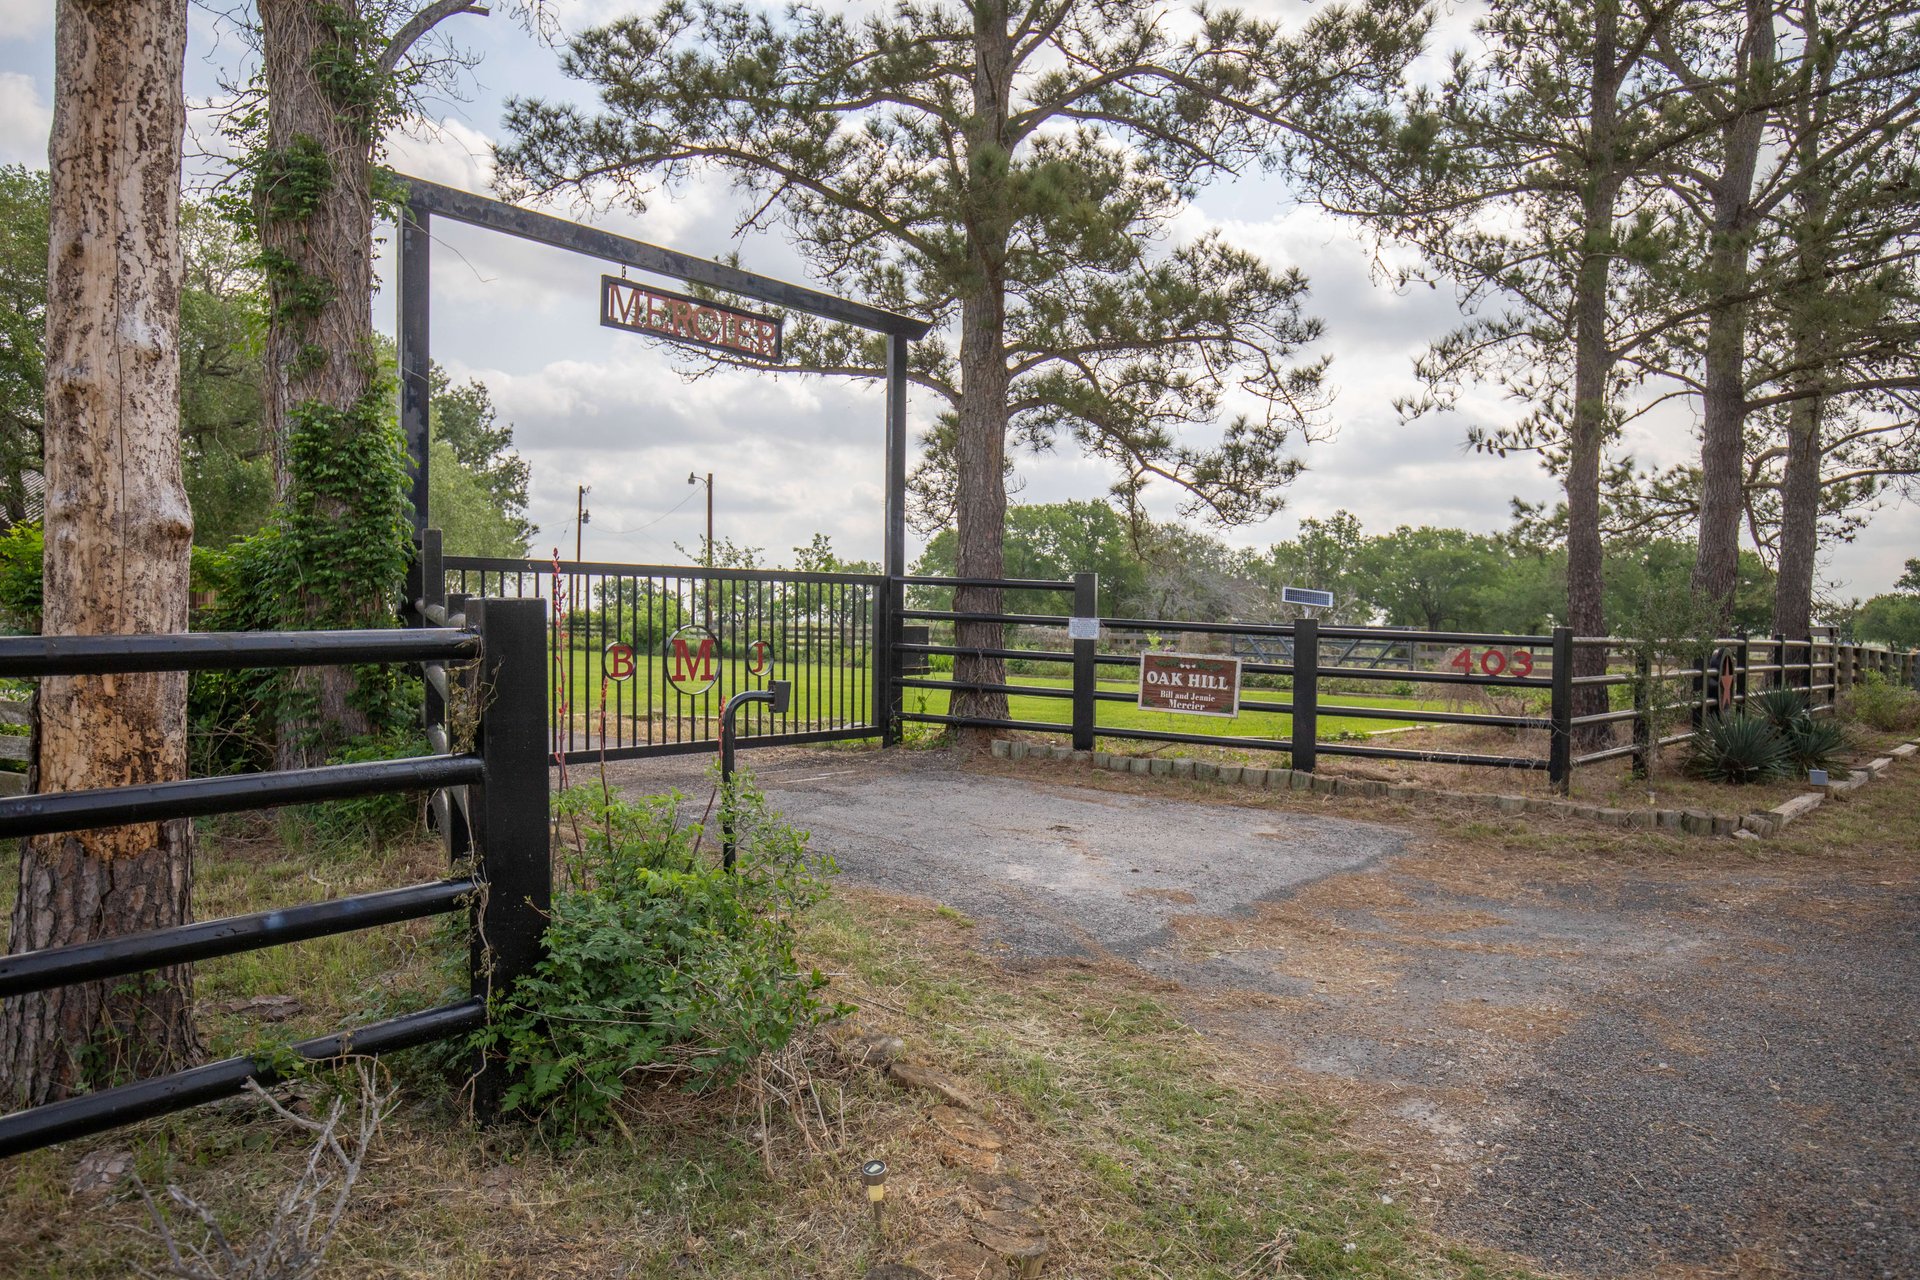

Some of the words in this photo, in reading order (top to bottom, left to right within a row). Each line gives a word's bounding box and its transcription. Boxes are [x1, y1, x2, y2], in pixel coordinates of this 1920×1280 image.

[608, 283, 779, 358] MERCIER
[610, 644, 635, 678] B
[671, 639, 715, 682] M
[752, 641, 768, 673] J
[1451, 647, 1534, 678] 403
[1146, 671, 1184, 687] OAK
[1187, 673, 1229, 690] HILL
[1160, 690, 1173, 699] Bill
[1175, 692, 1189, 700] and
[1190, 692, 1216, 703] Jennie
[1168, 699, 1206, 711] Mercier
